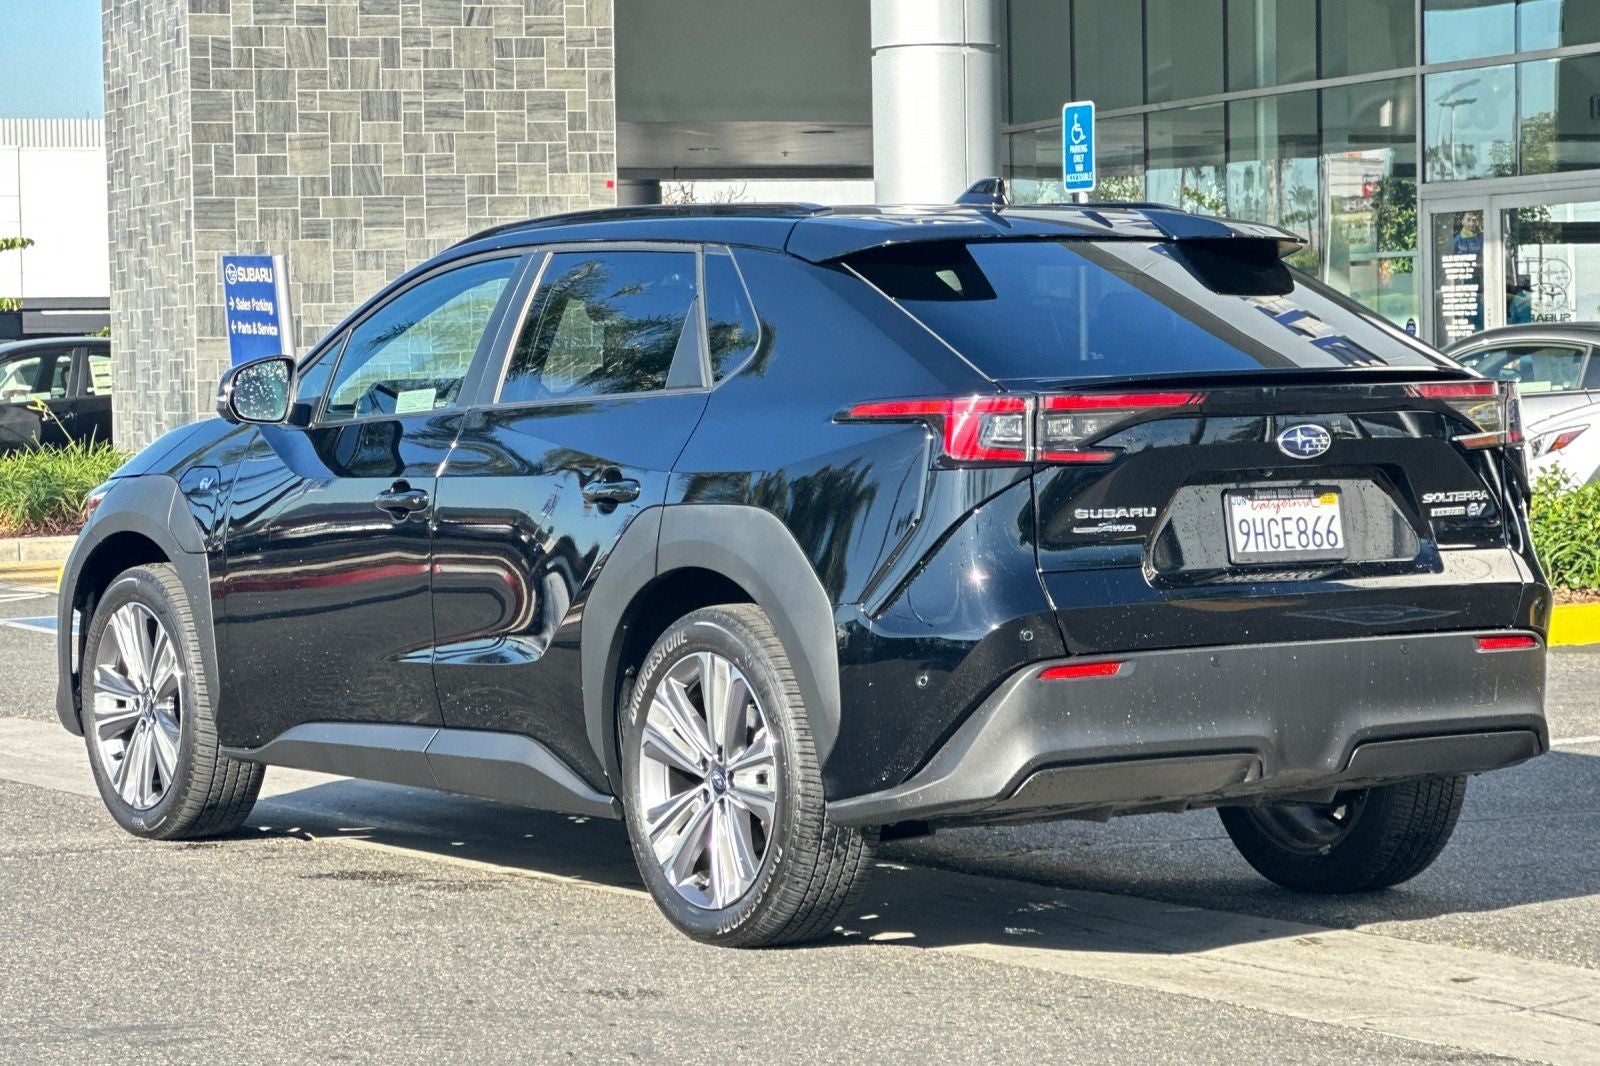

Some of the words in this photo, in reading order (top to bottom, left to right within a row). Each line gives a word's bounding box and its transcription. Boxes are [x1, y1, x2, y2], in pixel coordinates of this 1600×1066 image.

[237, 267, 273, 283] SUBARU
[236, 297, 252, 311] Sales
[252, 298, 274, 316] Parking
[238, 321, 252, 334] Parts
[253, 321, 258, 335] &
[258, 321, 278, 336] Service
[1422, 490, 1489, 503] SOLTERRA
[1074, 507, 1157, 519] SUBARU
[1467, 502, 1487, 517] EV
[1238, 514, 1339, 551] 9HGE866
